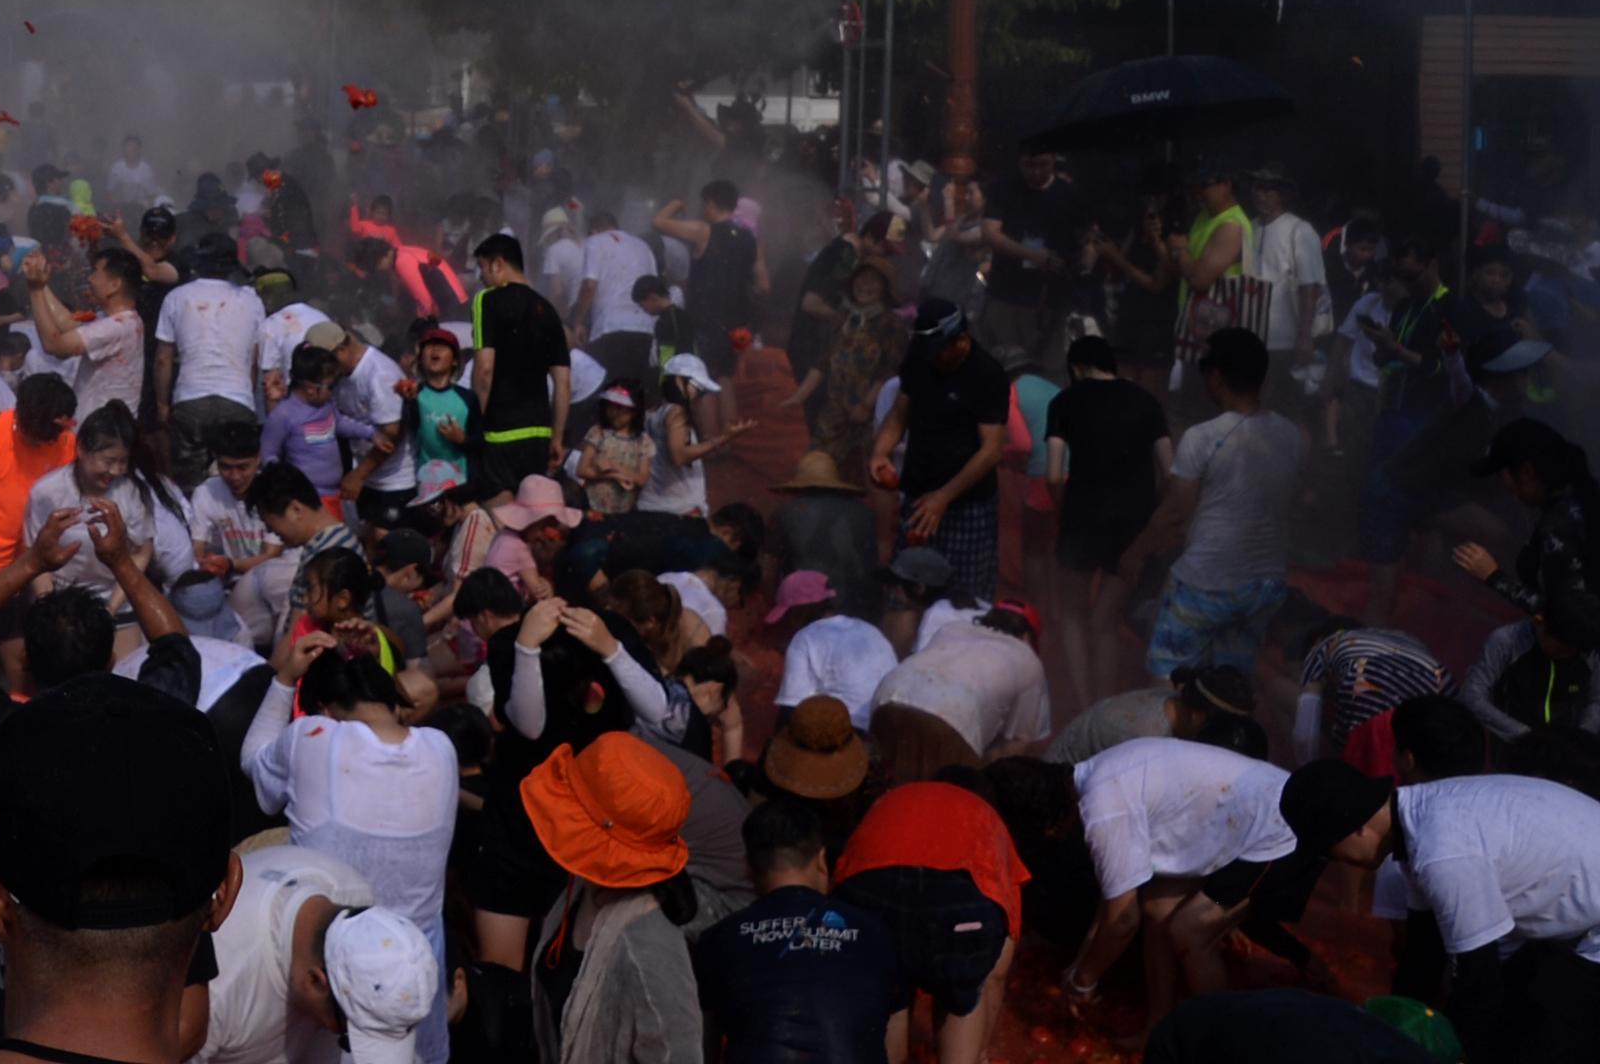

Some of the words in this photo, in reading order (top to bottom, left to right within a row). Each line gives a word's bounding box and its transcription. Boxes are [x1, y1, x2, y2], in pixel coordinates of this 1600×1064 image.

[1131, 89, 1170, 104] BMW
[740, 916, 807, 934] SUFFER
[753, 929, 794, 944] NOW
[800, 928, 860, 941] SUMMIT
[789, 937, 842, 952] LATER
